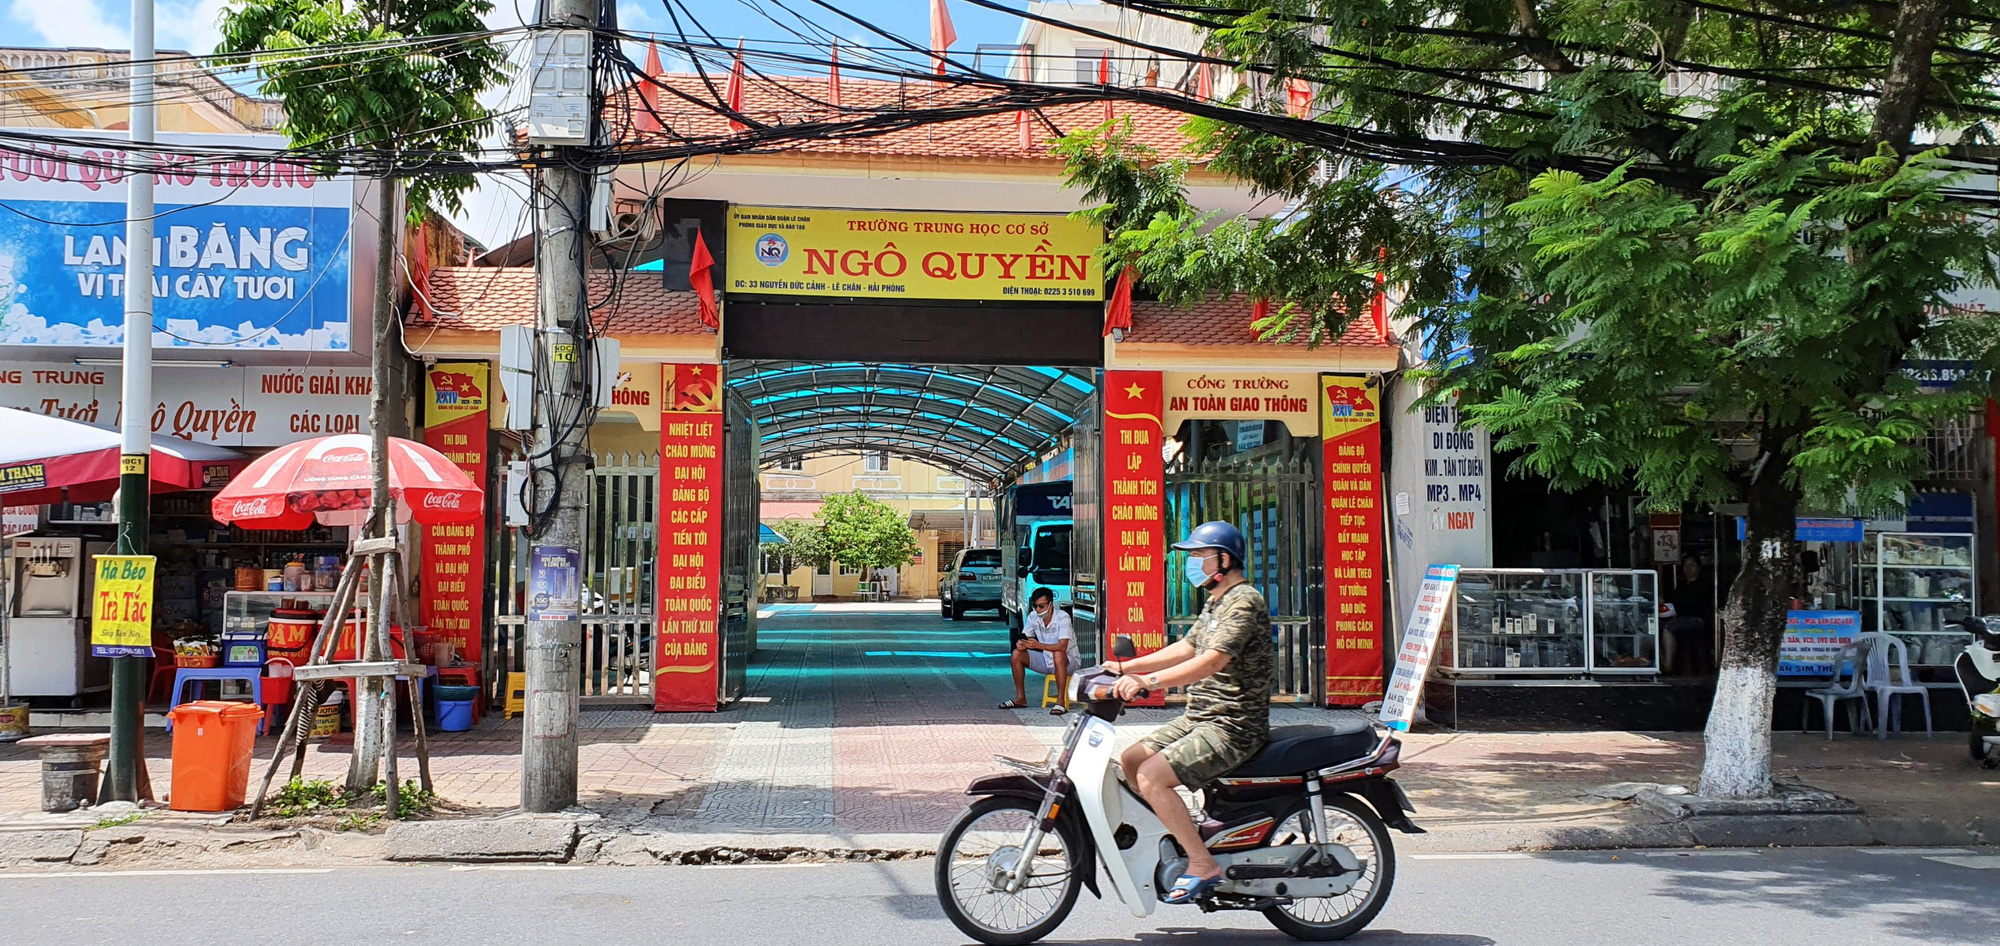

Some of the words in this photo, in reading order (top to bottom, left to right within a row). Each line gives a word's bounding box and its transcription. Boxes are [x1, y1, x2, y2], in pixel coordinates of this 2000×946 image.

[847, 219, 909, 233] TRƯỜNG
[913, 222, 966, 235] TRUNG
[969, 223, 1001, 236] HỌC
[1005, 222, 1027, 236] CƠ
[1030, 221, 1049, 236] SỞ
[169, 222, 309, 272] BĂNG
[802, 241, 908, 278] NGÔ
[921, 239, 1091, 281] QUYỀN
[77, 272, 105, 299] VỊ
[174, 273, 226, 299] CÂY
[233, 274, 294, 300] TƯƠI
[735, 280, 747, 288] ĐC:
[749, 280, 758, 288] 33
[790, 280, 804, 290] ĐỨC
[806, 280, 826, 290] CẢNH
[832, 282, 841, 290] LÊ
[842, 282, 861, 292] CHÂN
[867, 283, 879, 292] HẢI
[881, 283, 905, 293] PHÒNG
[1002, 285, 1019, 297] ĐIỆN
[1044, 288, 1060, 297] 0225
[1060, 288, 1066, 297] 3
[1068, 288, 1081, 297] 510
[1082, 289, 1096, 298] 699
[32, 371, 105, 385] TRUNG
[261, 371, 304, 395] NƯỚC
[308, 370, 341, 396] GIẢI
[1187, 374, 1226, 390] CỔNG
[1233, 376, 1289, 390] TRƯỜNG
[436, 391, 459, 404] XXIV
[1169, 396, 1189, 411] AN
[1193, 393, 1226, 412] TOÀN
[1230, 397, 1260, 412] GIAO
[1264, 394, 1308, 413] THÔNG
[172, 397, 257, 441] Quyền
[1332, 404, 1353, 417] XXIV
[290, 413, 322, 434] CÁC
[669, 420, 695, 439] NHIỆT
[696, 421, 713, 439] LIỆT
[443, 434, 454, 446] THI
[454, 434, 467, 446] ĐUA
[1120, 430, 1132, 445] THI
[1133, 430, 1150, 445] ĐUA
[1433, 432, 1443, 450] DI
[1446, 431, 1474, 453] ĐỘNG
[466, 450, 481, 464] TÍCH
[665, 441, 689, 458] CHÀO
[690, 442, 716, 459] MỪNG
[1127, 451, 1143, 473] LẬP
[1424, 459, 1438, 476] KIM
[674, 466, 690, 483] ĐẠI
[691, 464, 706, 483] HỘI
[1112, 477, 1139, 496] THÀNH
[1140, 477, 1158, 495] TÍCH
[1350, 478, 1359, 491] VÀ
[1426, 484, 1449, 502] MP3
[1458, 483, 1482, 502] MP4
[672, 484, 696, 502] ĐẢNG
[697, 486, 710, 505] BỘ
[670, 507, 689, 524] CÁC
[690, 506, 708, 524] CẤP
[1111, 502, 1133, 521] CHÀO
[1134, 502, 1158, 521] MỪNG
[1447, 511, 1475, 530] NGAY
[465, 523, 475, 540] BỘ
[672, 528, 692, 546] TIẾN
[693, 529, 708, 546] TỚI
[1121, 530, 1135, 549] ĐẠI
[1136, 527, 1150, 549] HỘI
[434, 541, 457, 556] THÀNH
[457, 540, 472, 556] PHỐ
[100, 560, 117, 581] Hà
[121, 558, 147, 581] Béo
[435, 560, 444, 574] VÀ
[444, 562, 456, 577] ĐẠI
[456, 560, 469, 576] HỘI
[672, 554, 688, 570] ĐẠI
[689, 551, 704, 570] HỘI
[1119, 551, 1135, 572] LẦN
[1136, 554, 1152, 571] THỨ
[669, 576, 685, 593] ĐẠI
[686, 570, 706, 590] BIỂU
[1333, 566, 1343, 579] VÀ
[1357, 567, 1373, 579] THEO
[437, 581, 450, 595] ĐẠI
[450, 576, 466, 592] BIỂU
[1126, 581, 1145, 598] XXIV
[100, 589, 118, 622] Trà
[123, 583, 147, 622] Tắc
[432, 597, 451, 611] TOÀN
[450, 596, 470, 612] QUỐC
[664, 594, 688, 611] TOÀN
[689, 593, 712, 612] QUỐC
[1127, 601, 1144, 623] CỦA
[444, 617, 458, 630] THỨ
[458, 618, 471, 630] XIII
[661, 615, 680, 634] LẦN
[680, 616, 699, 634] THỨ
[699, 620, 714, 634] XIII
[664, 638, 683, 656] CỦA
[683, 638, 709, 656] ĐẢNG
[1142, 629, 1163, 652] QUẬN
